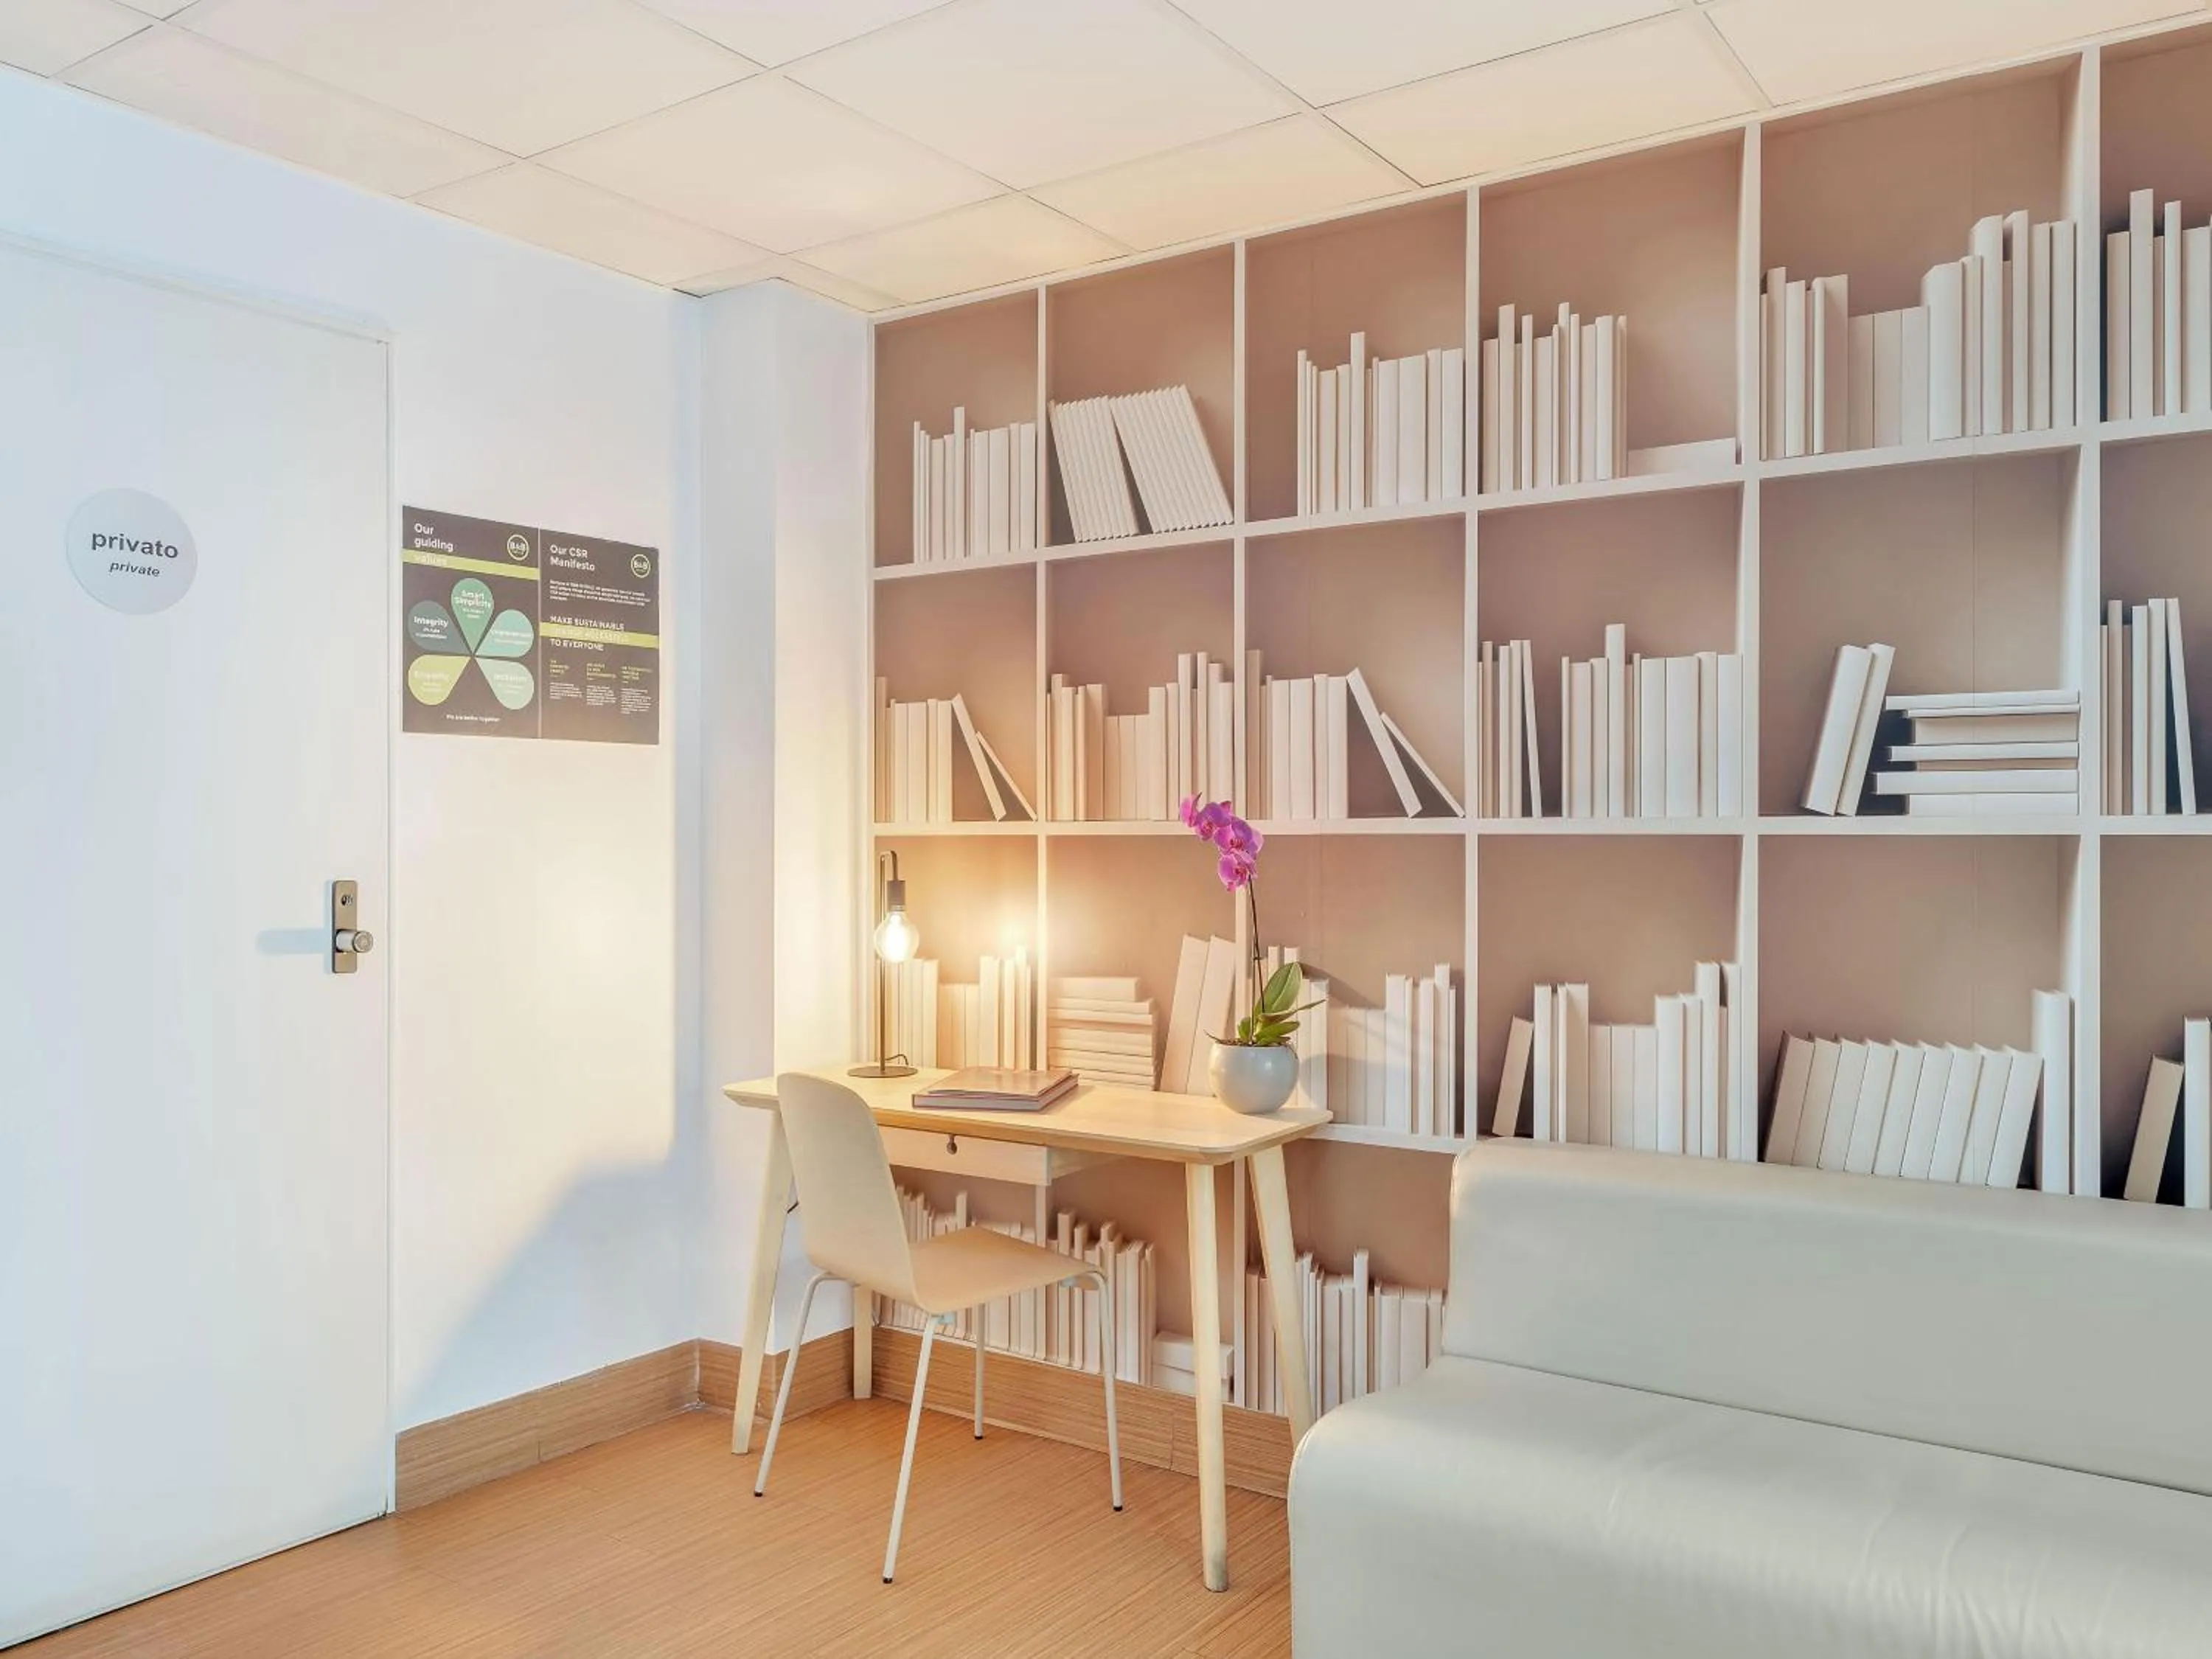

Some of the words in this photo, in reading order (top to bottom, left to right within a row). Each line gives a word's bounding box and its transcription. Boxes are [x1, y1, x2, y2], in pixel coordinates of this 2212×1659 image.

[414, 523, 434, 535] Our
[91, 532, 178, 558] privato
[414, 537, 453, 552] guiding
[550, 543, 567, 554] Our
[568, 547, 588, 557] CSR
[109, 562, 160, 577] private
[550, 556, 595, 571] Manifesto
[414, 616, 448, 627] Integrity
[550, 616, 573, 625] MAKE
[574, 619, 625, 631] SUSTAINABLE
[550, 639, 561, 647] TO
[563, 639, 604, 651] EVERYONE
